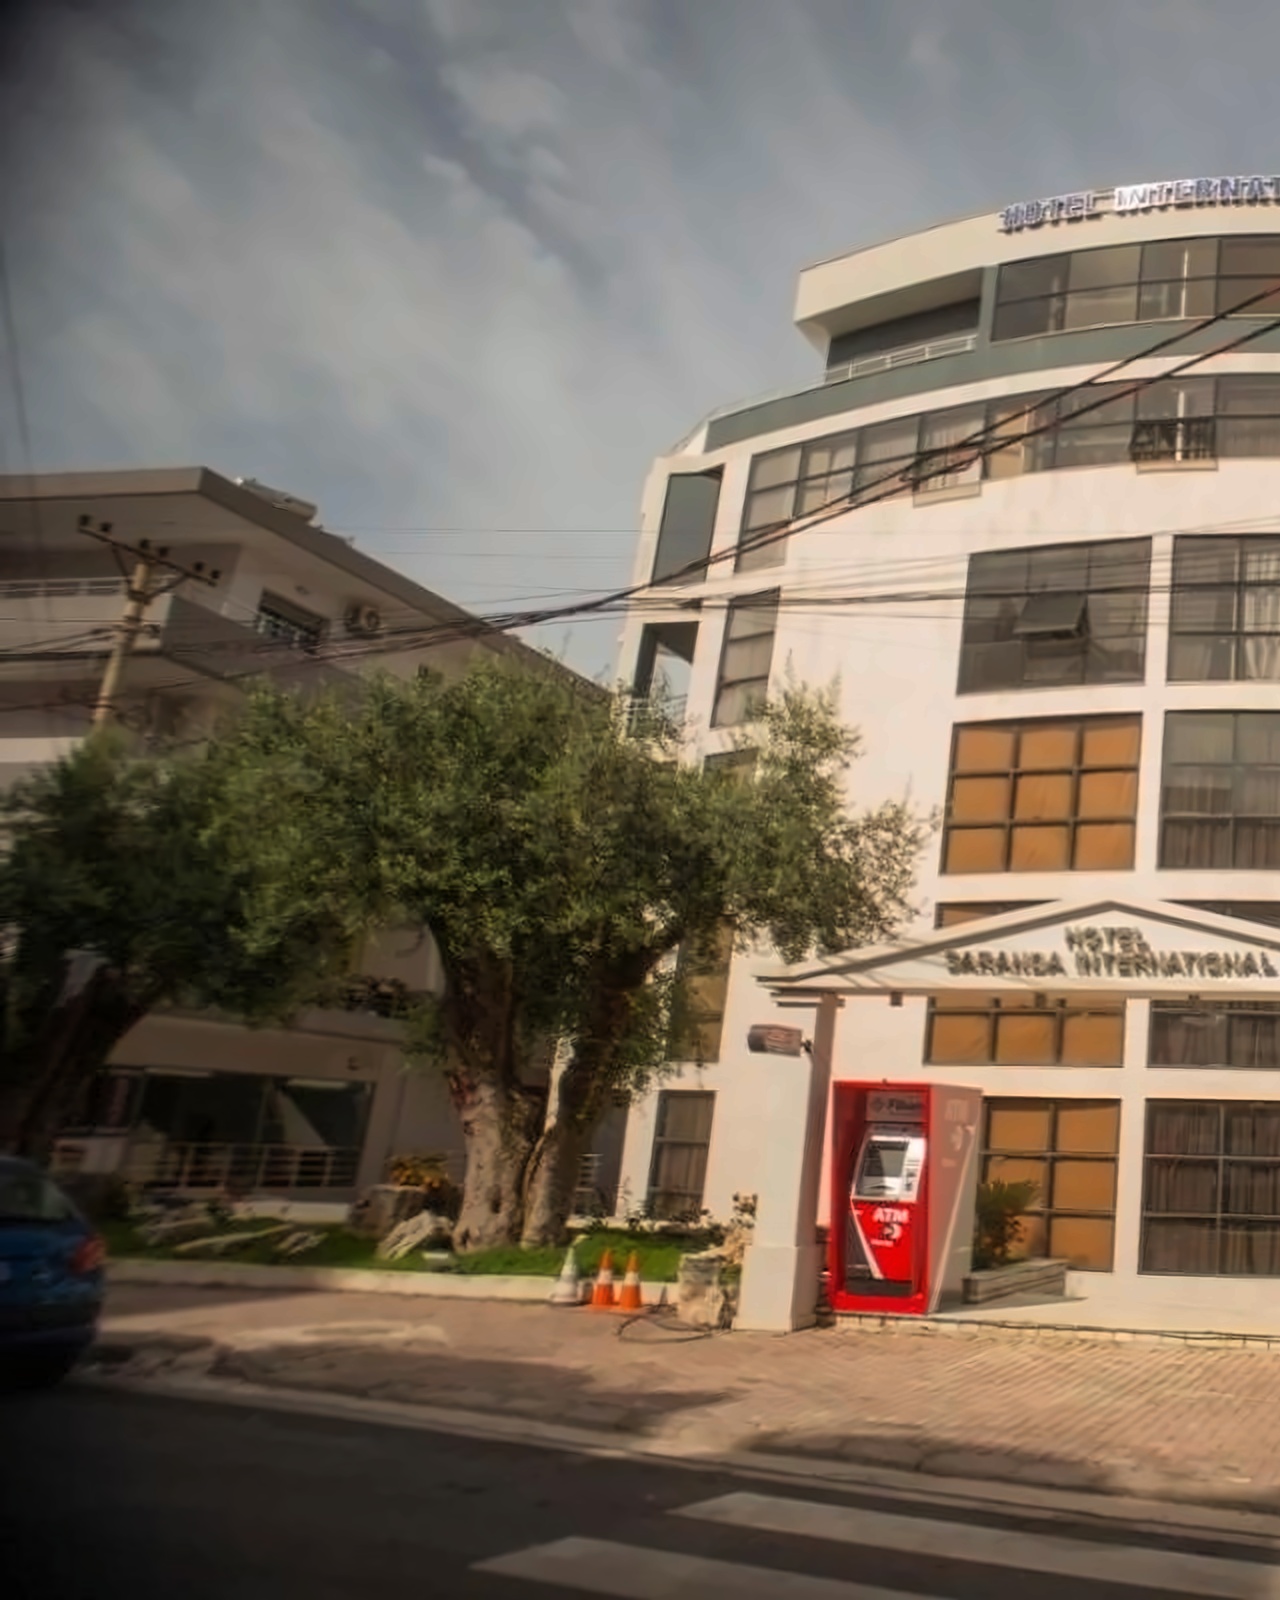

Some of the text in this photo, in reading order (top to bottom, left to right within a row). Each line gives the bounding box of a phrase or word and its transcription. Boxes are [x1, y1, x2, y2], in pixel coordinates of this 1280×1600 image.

[1000, 193, 1099, 231] HOTEL
[1064, 926, 1148, 951] HOTEL
[1074, 949, 1280, 978] INTERNATIONAL
[872, 1207, 909, 1223] ATM
